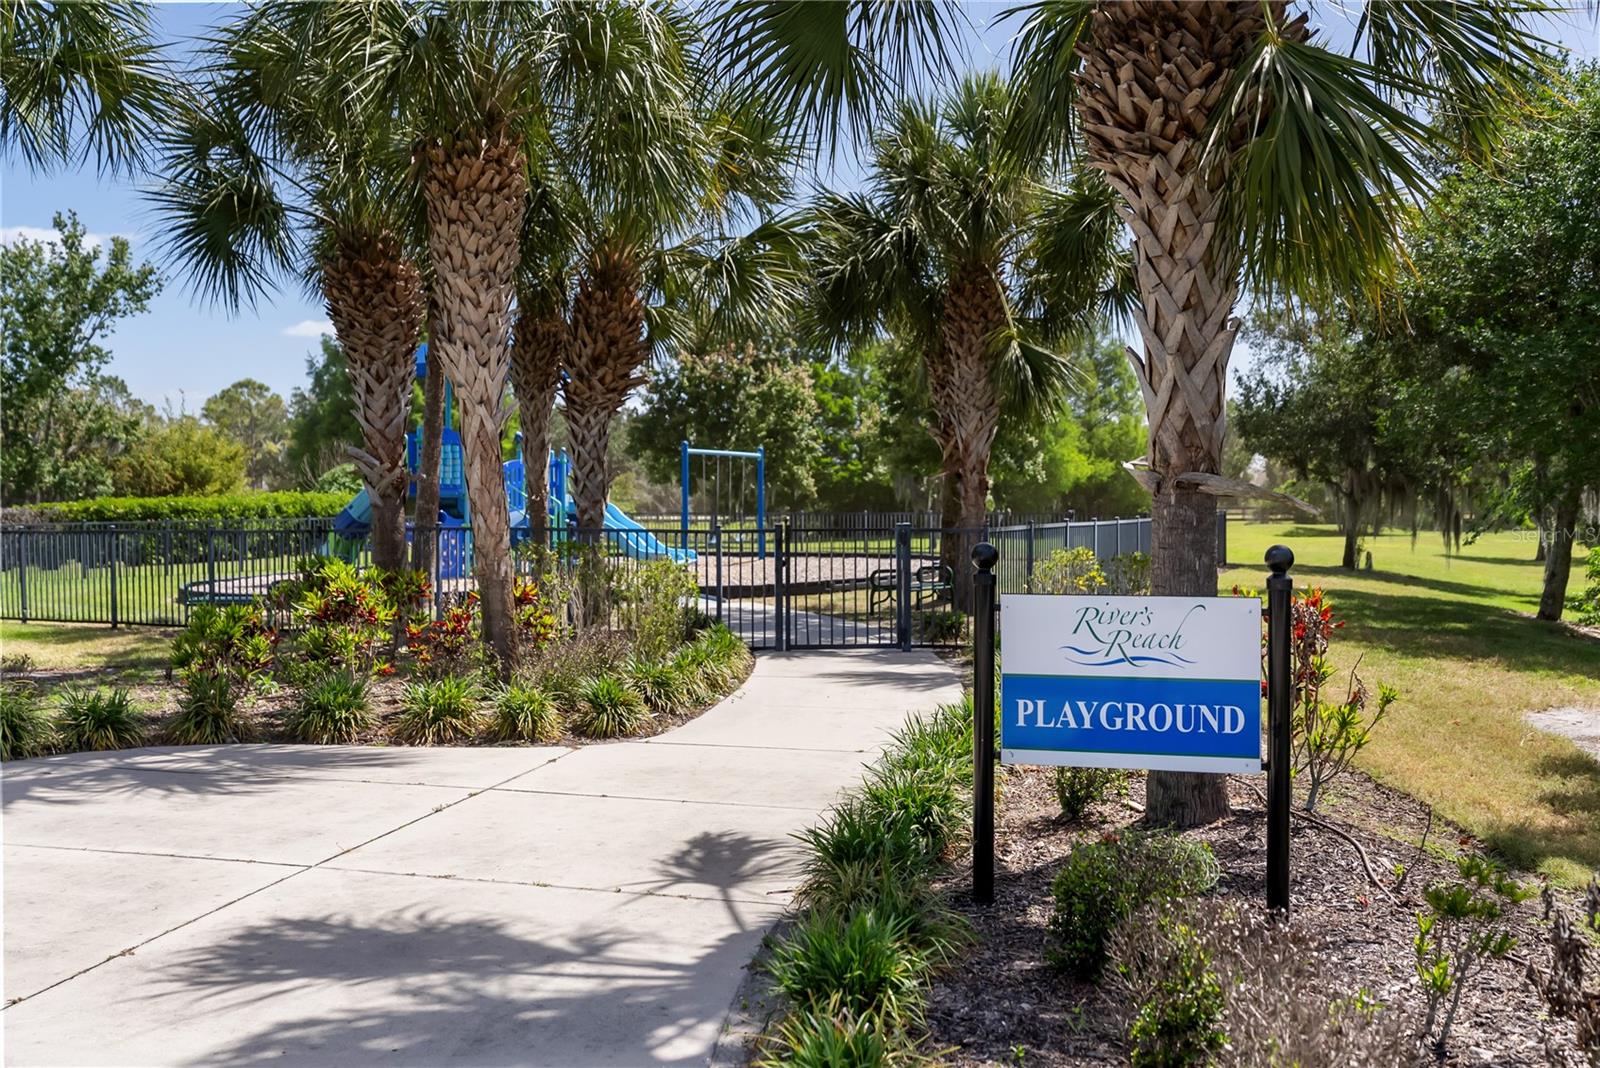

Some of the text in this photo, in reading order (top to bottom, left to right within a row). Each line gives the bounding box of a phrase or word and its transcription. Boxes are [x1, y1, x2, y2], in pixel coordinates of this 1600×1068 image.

[1072, 602, 1154, 645] River's
[1104, 604, 1207, 668] Reach
[1015, 699, 1246, 735] PLAYGROUND
